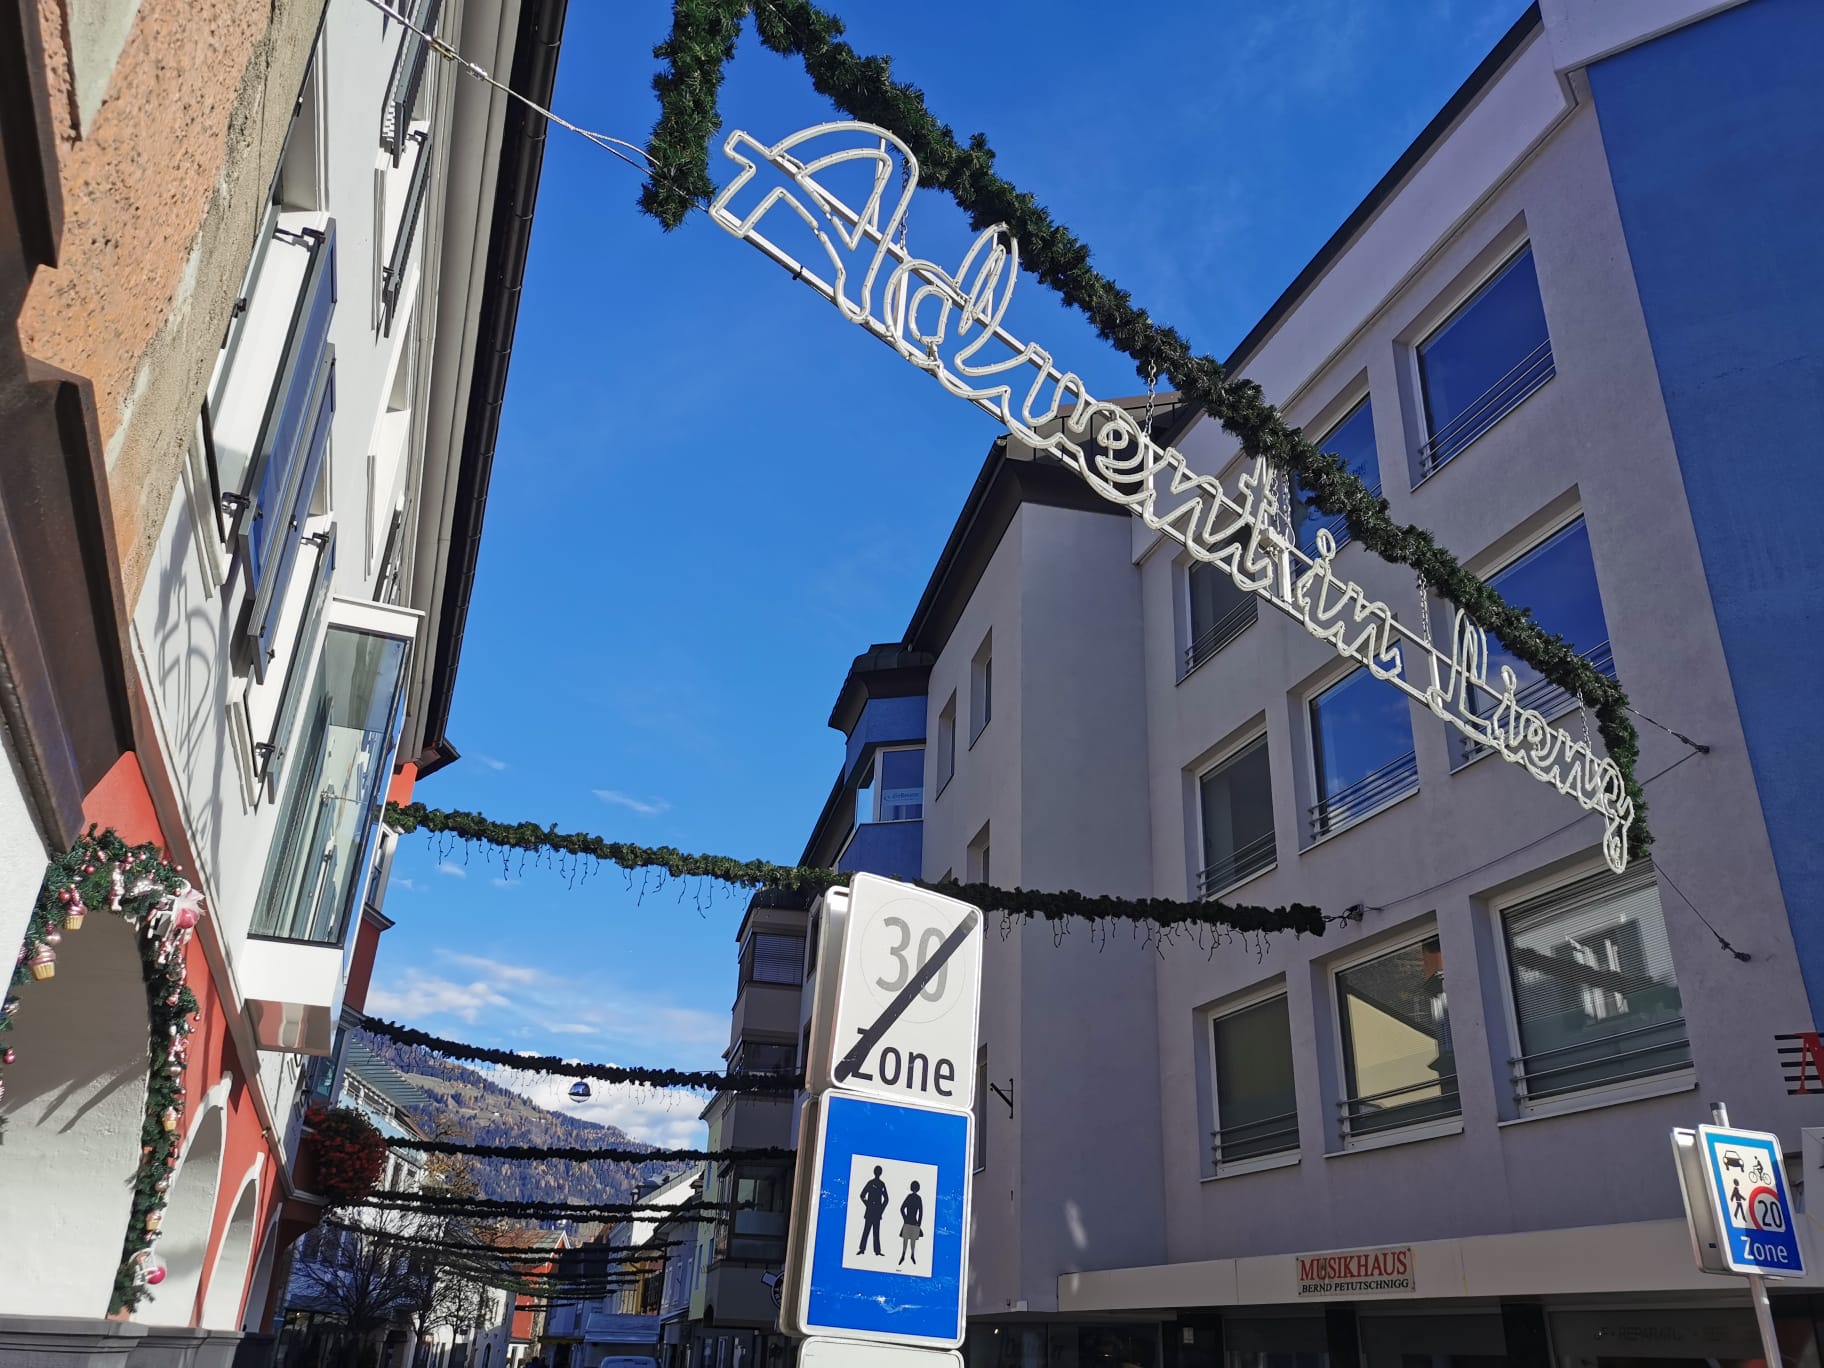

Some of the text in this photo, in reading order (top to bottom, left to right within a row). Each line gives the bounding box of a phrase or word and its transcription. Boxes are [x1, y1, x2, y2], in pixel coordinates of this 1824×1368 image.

[1297, 527, 1402, 680] in
[876, 916, 949, 1002] 30
[1757, 1199, 1783, 1229] 20
[1740, 1235, 1788, 1264] Zone
[1300, 1251, 1407, 1281] MUSIKHAUS
[1302, 1278, 1409, 1294] BERND PETUTSCHNIGG
